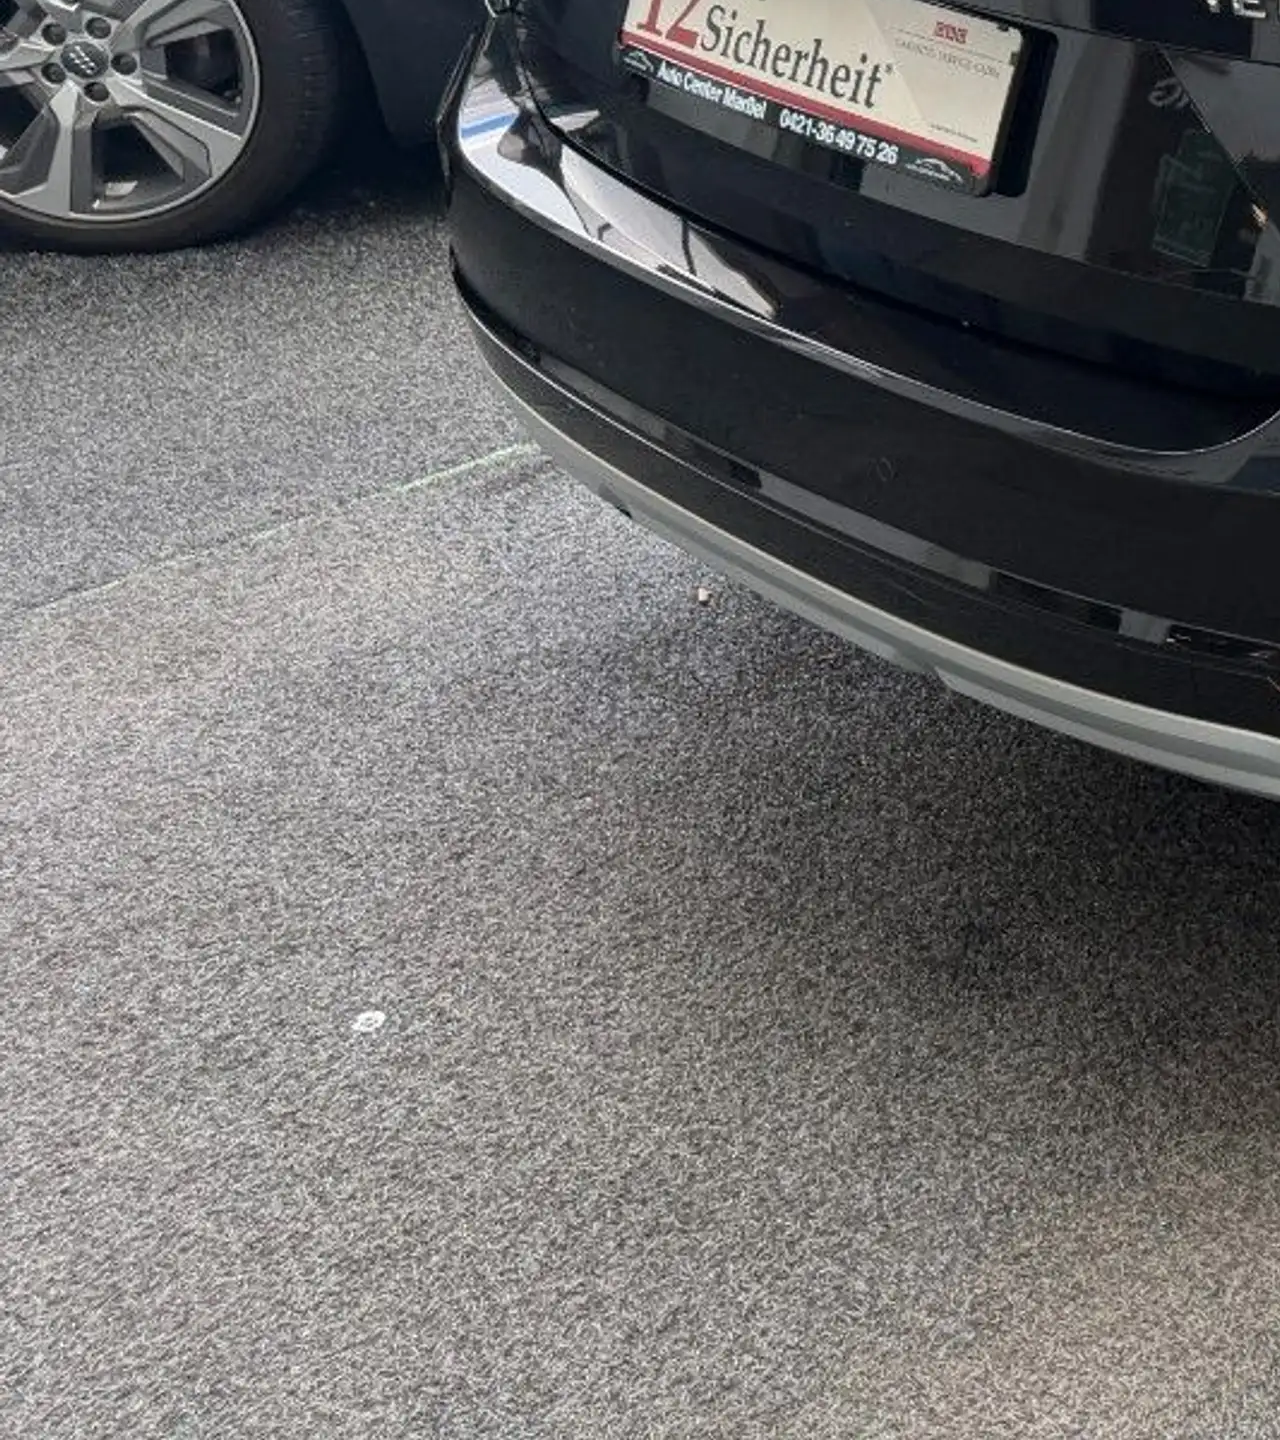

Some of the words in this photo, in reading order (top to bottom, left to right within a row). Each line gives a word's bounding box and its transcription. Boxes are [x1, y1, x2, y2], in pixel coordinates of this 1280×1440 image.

[656, 60, 683, 87] Auto
[683, 74, 723, 104] Center
[856, 133, 875, 158] 75
